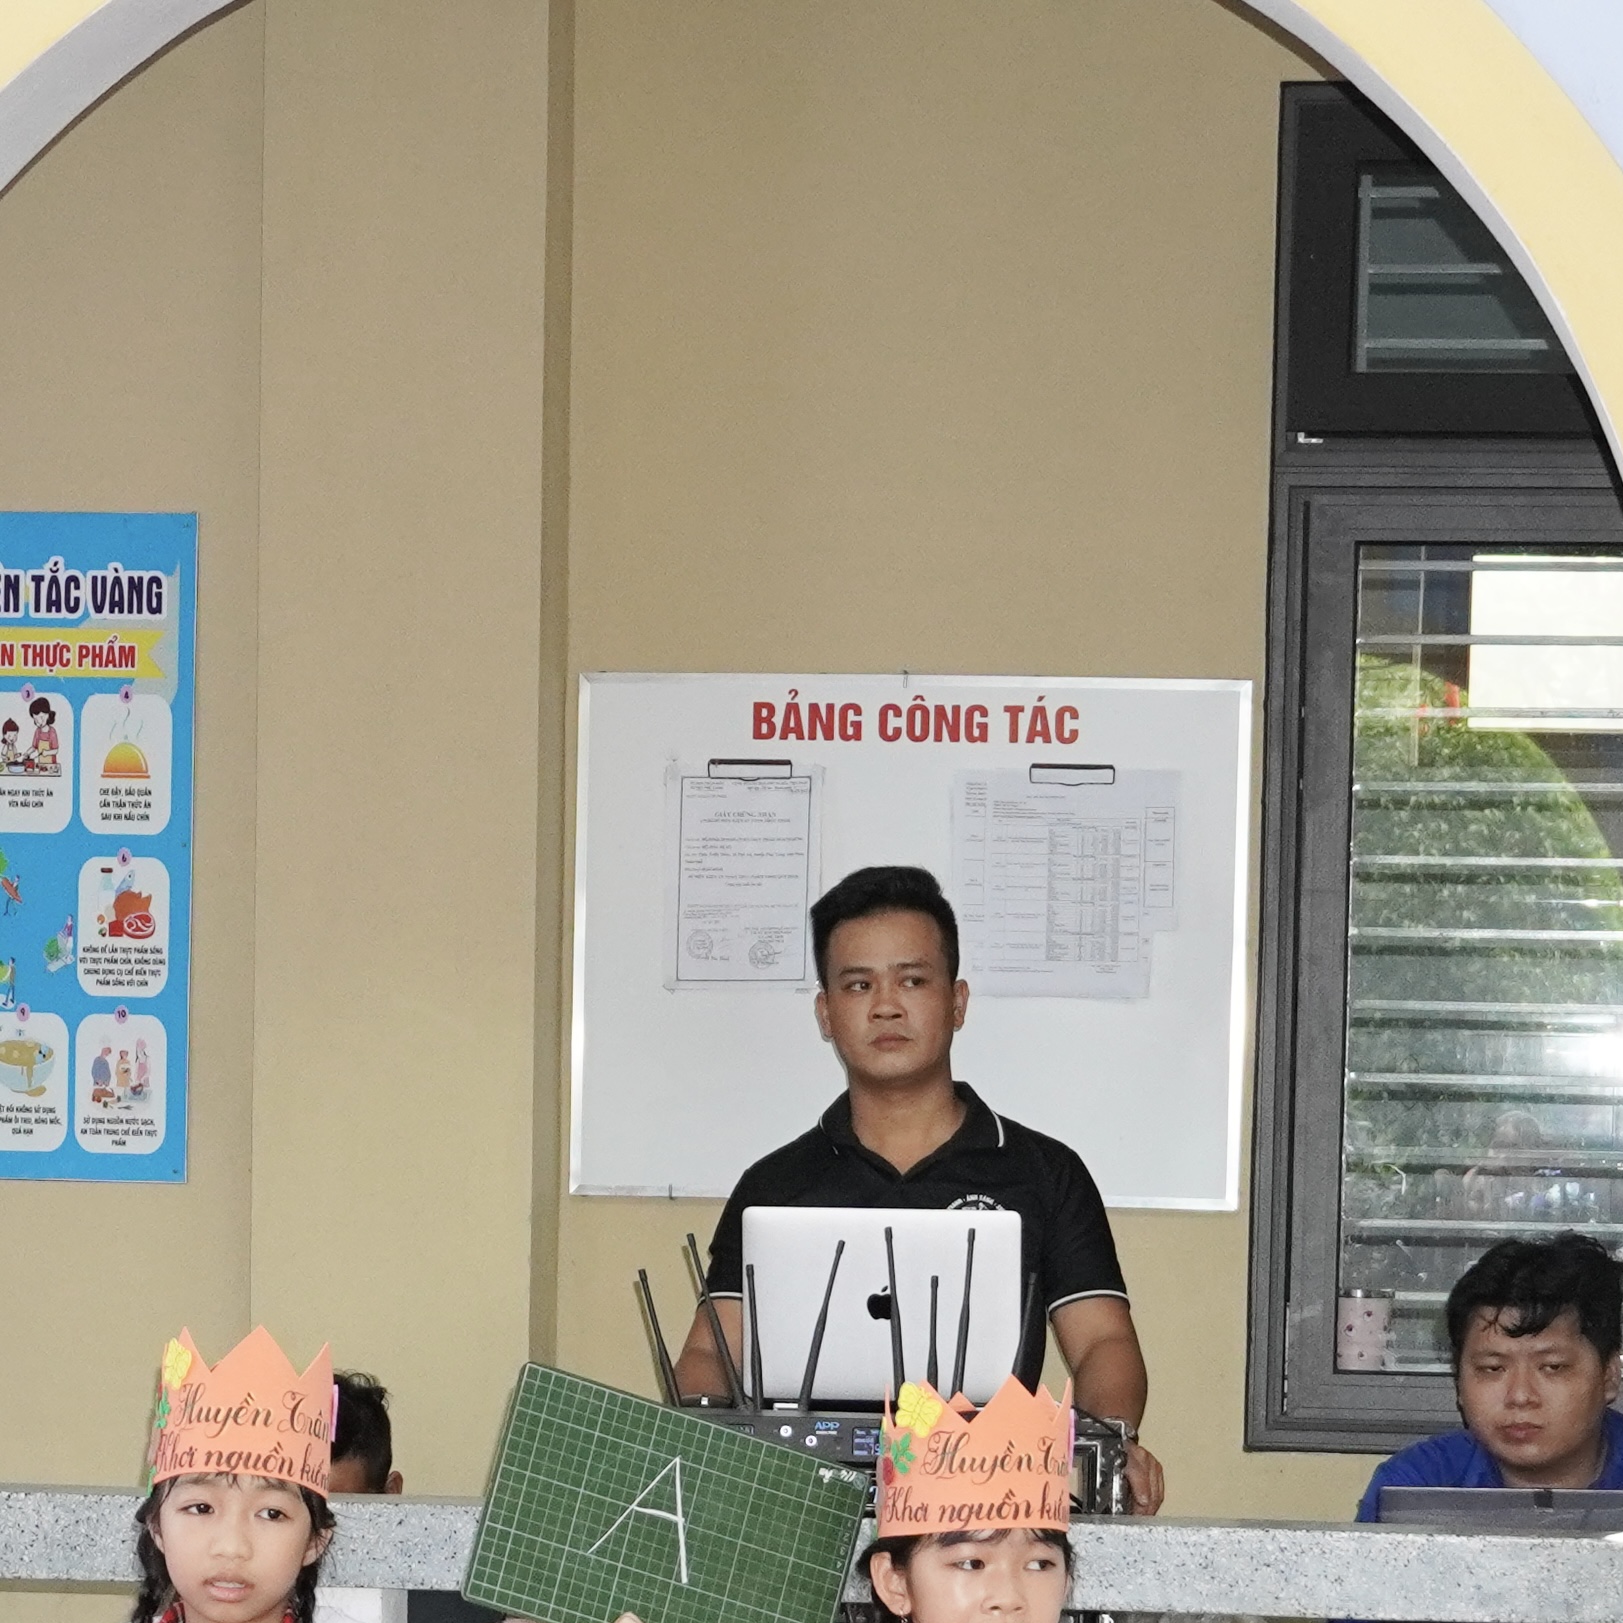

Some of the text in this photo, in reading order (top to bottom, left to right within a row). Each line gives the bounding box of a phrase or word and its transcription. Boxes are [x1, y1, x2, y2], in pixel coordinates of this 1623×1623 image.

[0, 561, 163, 614] N TẮC VÀNG
[21, 642, 71, 672] THỰC
[78, 636, 136, 668] PHẨM
[752, 689, 1080, 744] BẢNG CÔNG TÁC
[173, 1382, 330, 1444] Huyền Trân
[814, 1421, 840, 1431] APP
[204, 1441, 296, 1478] nguồn
[919, 1430, 1035, 1485] Huyền
[586, 1455, 690, 1585] A
[938, 1488, 1034, 1529] nguồn
